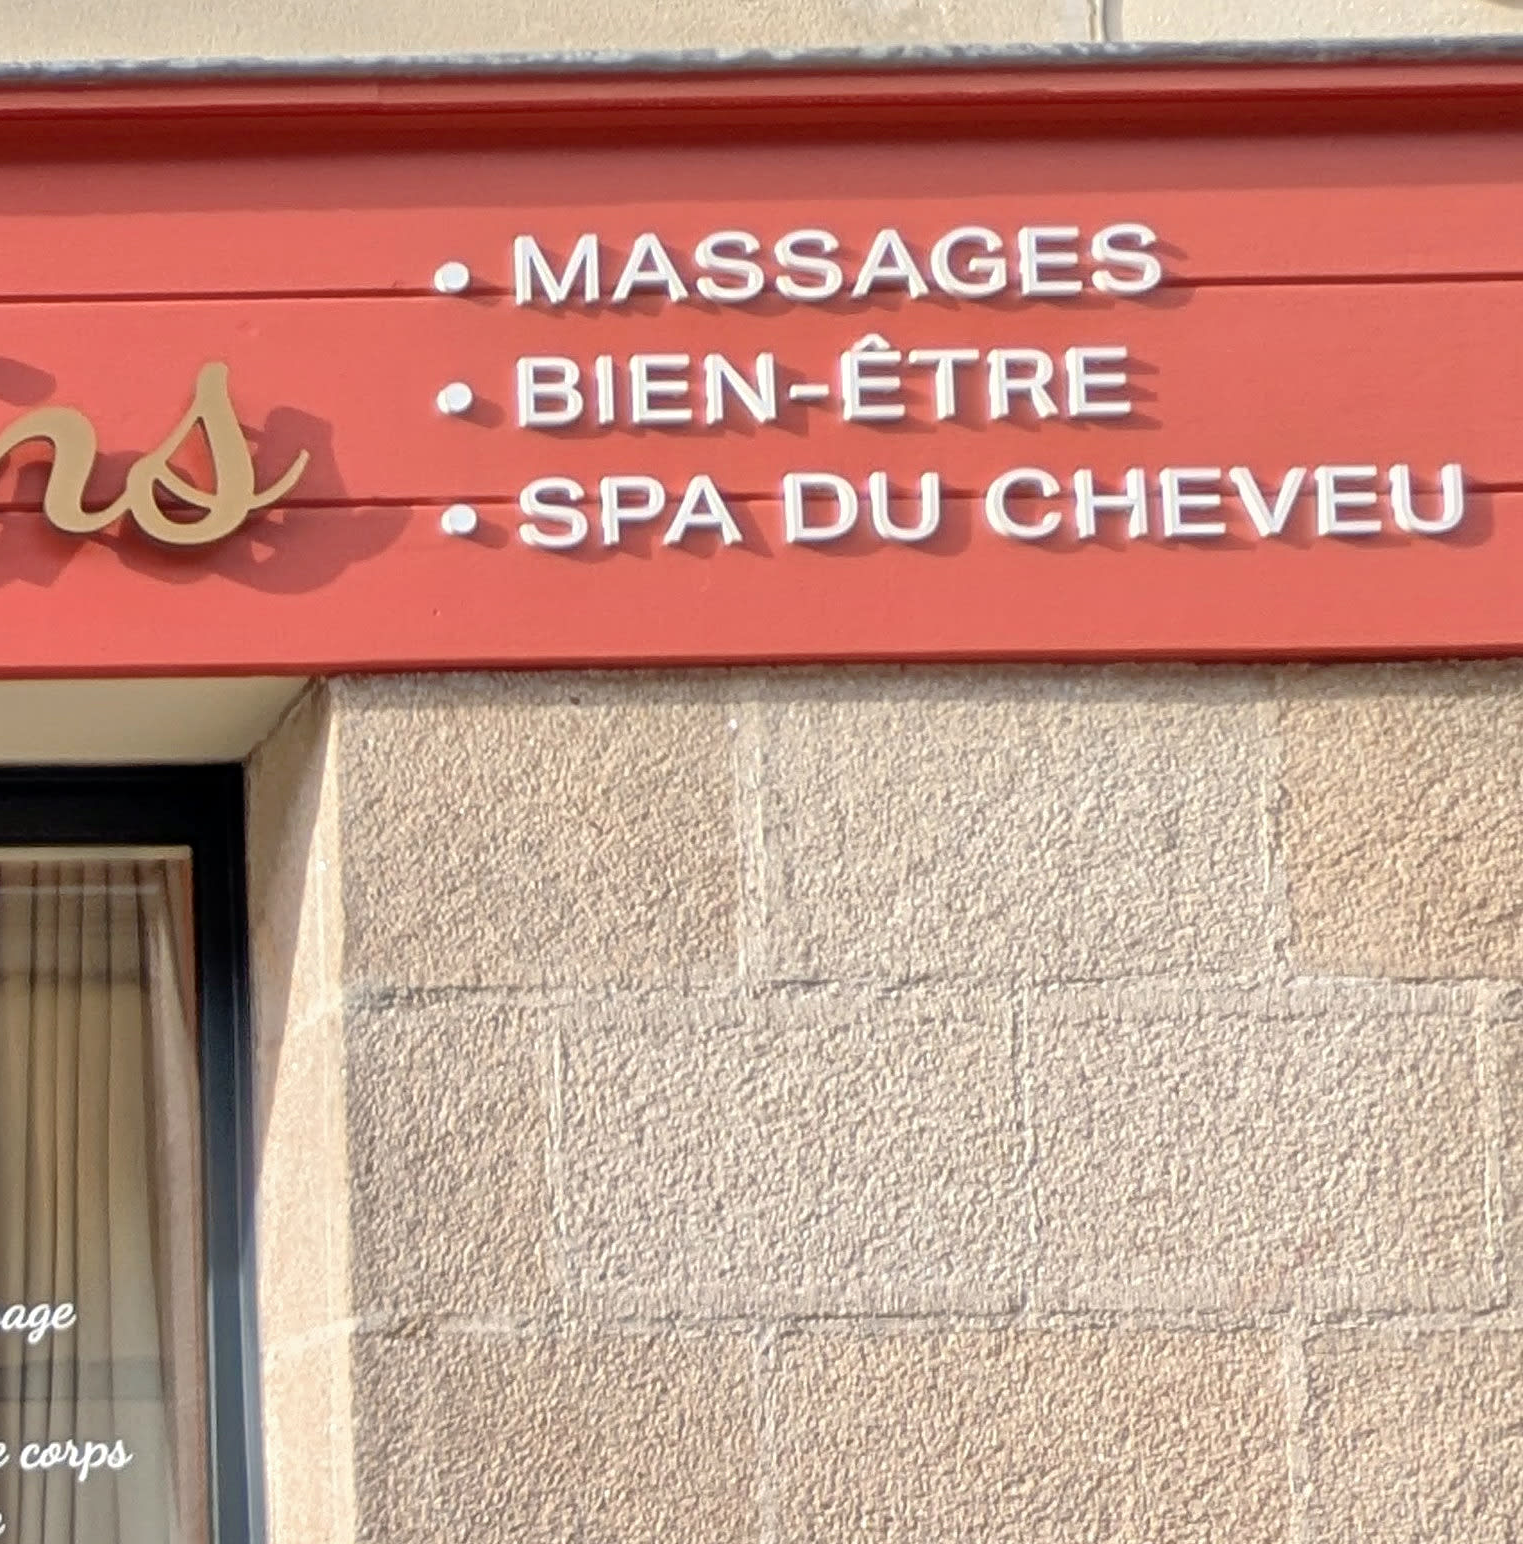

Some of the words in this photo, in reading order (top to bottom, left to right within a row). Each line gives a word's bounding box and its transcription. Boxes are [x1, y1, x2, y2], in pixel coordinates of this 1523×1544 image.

[512, 220, 1165, 308] MASSAGES
[513, 333, 1135, 428] BIEN-ÊTRE
[516, 474, 742, 552] SPA
[782, 468, 941, 545] DU
[985, 461, 1466, 540] CHEVEU
[19, 1435, 133, 1482] corps
